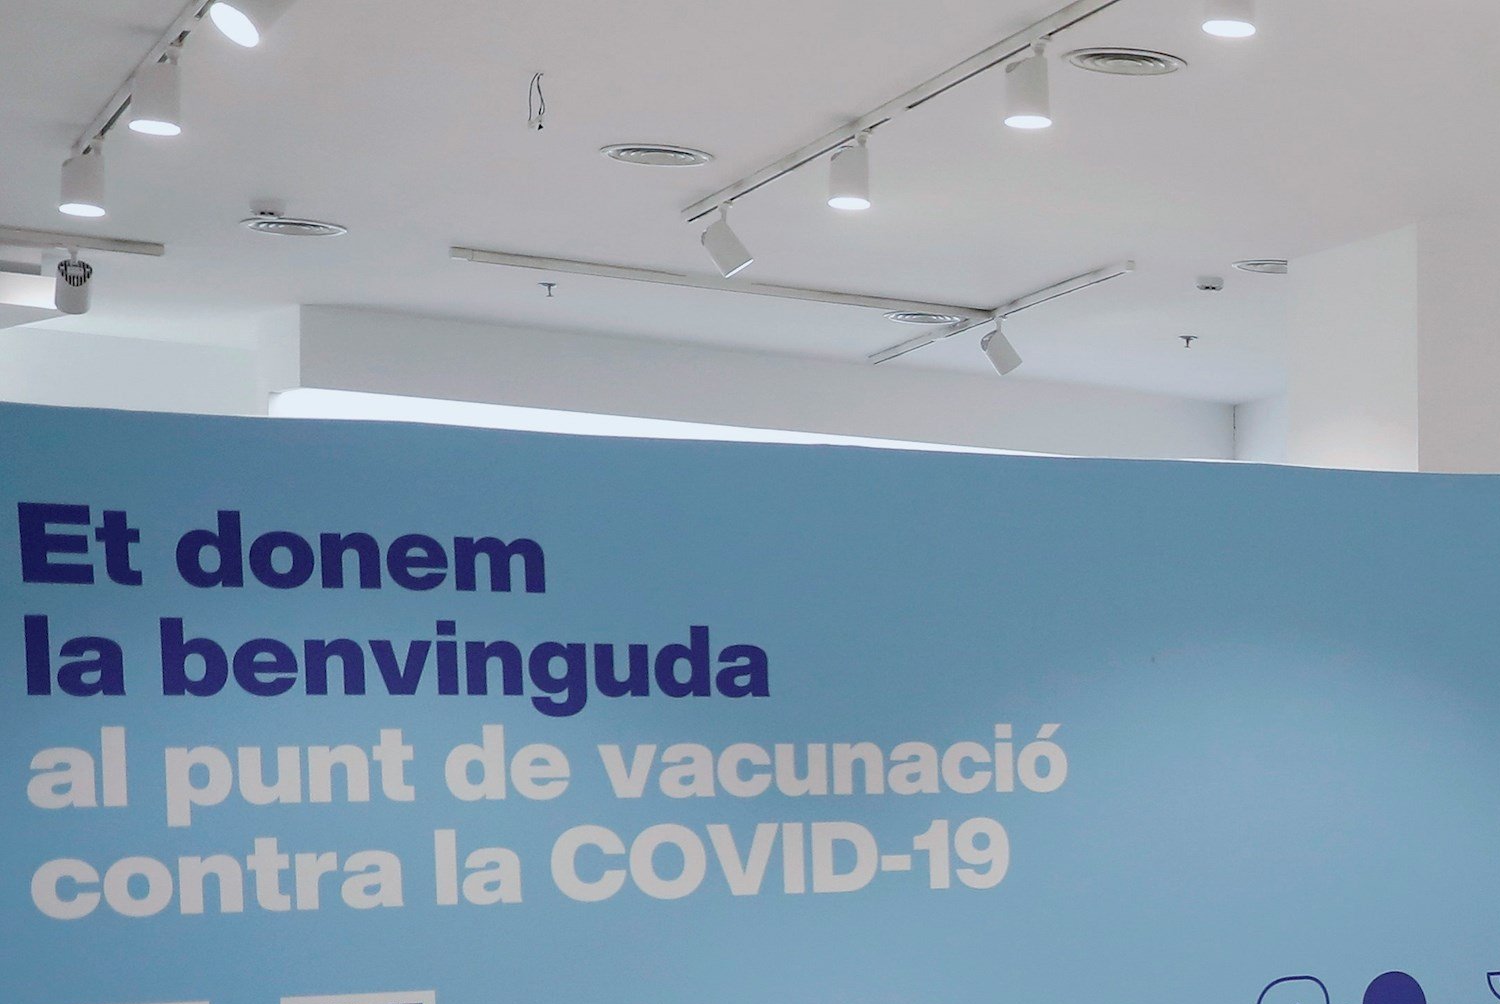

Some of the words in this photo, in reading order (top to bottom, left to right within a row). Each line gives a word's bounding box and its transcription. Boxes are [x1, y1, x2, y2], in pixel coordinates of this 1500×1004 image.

[17, 501, 143, 586] Et
[175, 509, 547, 594] donem
[23, 614, 127, 697] la
[159, 616, 771, 718] benvinguda
[26, 725, 129, 810] al
[164, 727, 416, 828] punt
[444, 723, 571, 802] de
[597, 723, 1069, 799] vacunació
[30, 836, 404, 921] contra
[433, 828, 524, 907] la
[550, 816, 1011, 903] COVID-19
